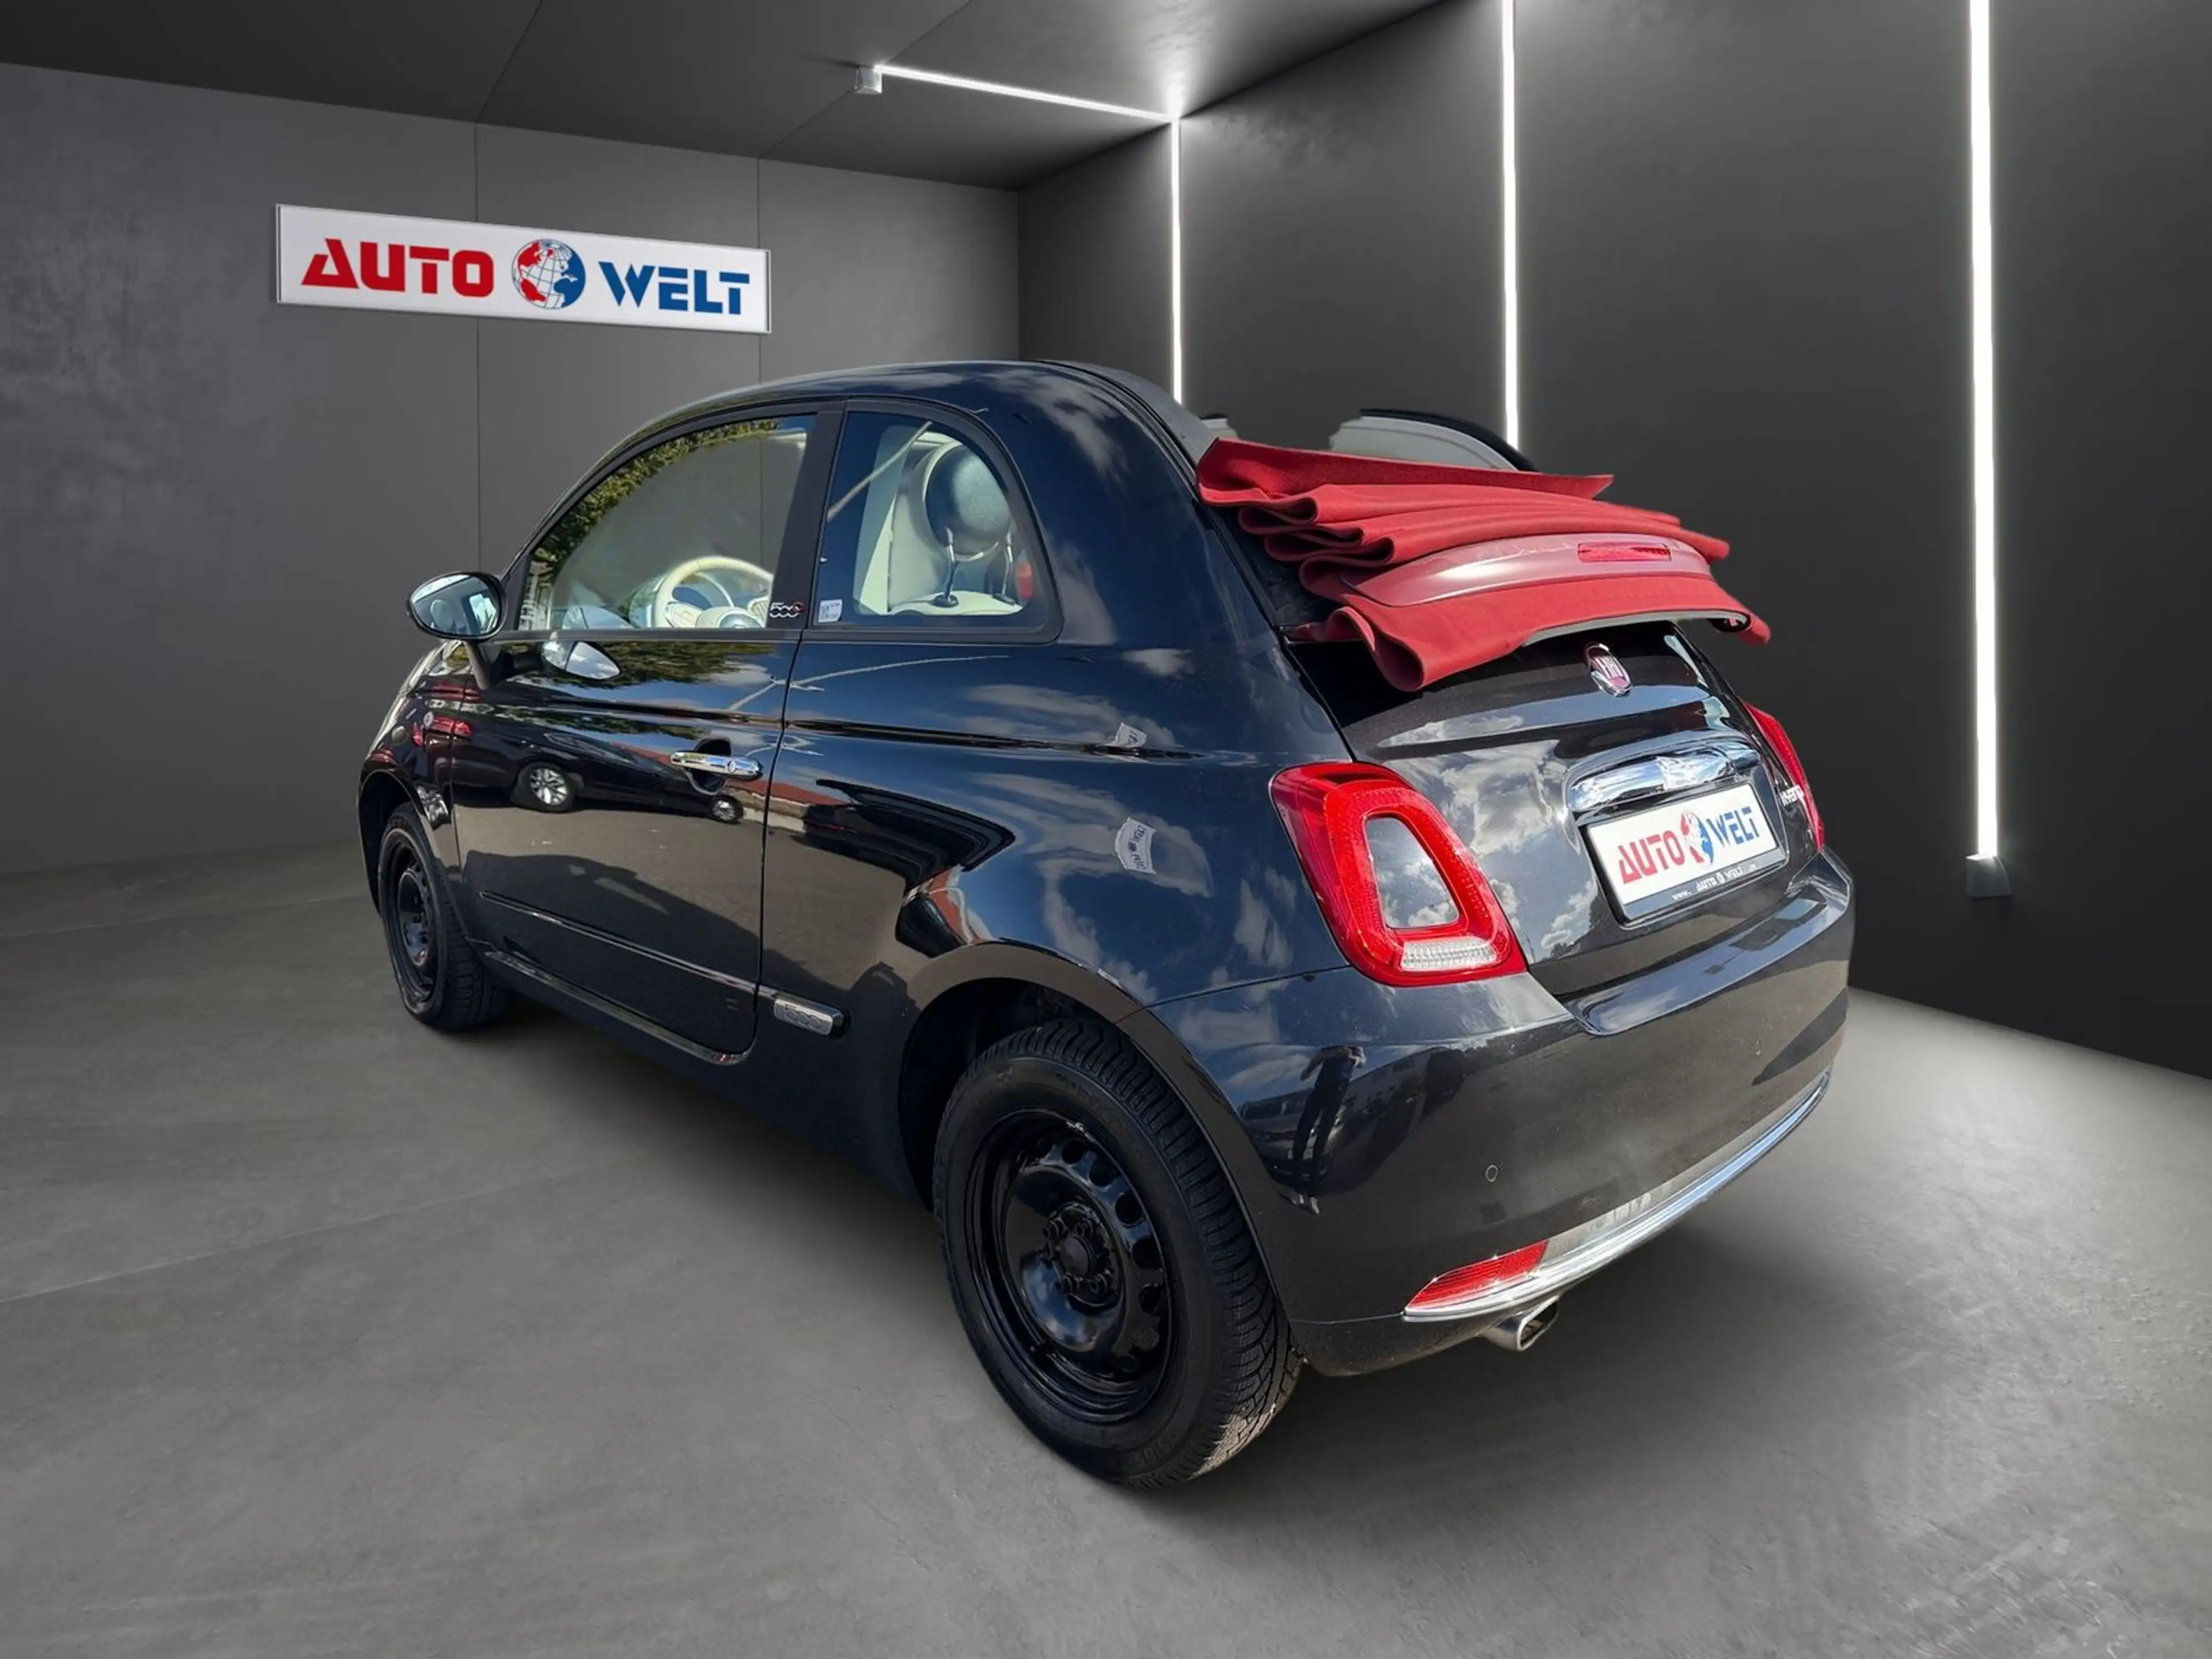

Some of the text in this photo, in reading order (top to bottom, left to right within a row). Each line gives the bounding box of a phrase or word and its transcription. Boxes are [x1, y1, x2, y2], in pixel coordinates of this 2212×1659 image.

[301, 238, 750, 315] AUTO WELT
[1618, 806, 1760, 885] AUTO WELT
[1696, 876, 1717, 892] AUTO
